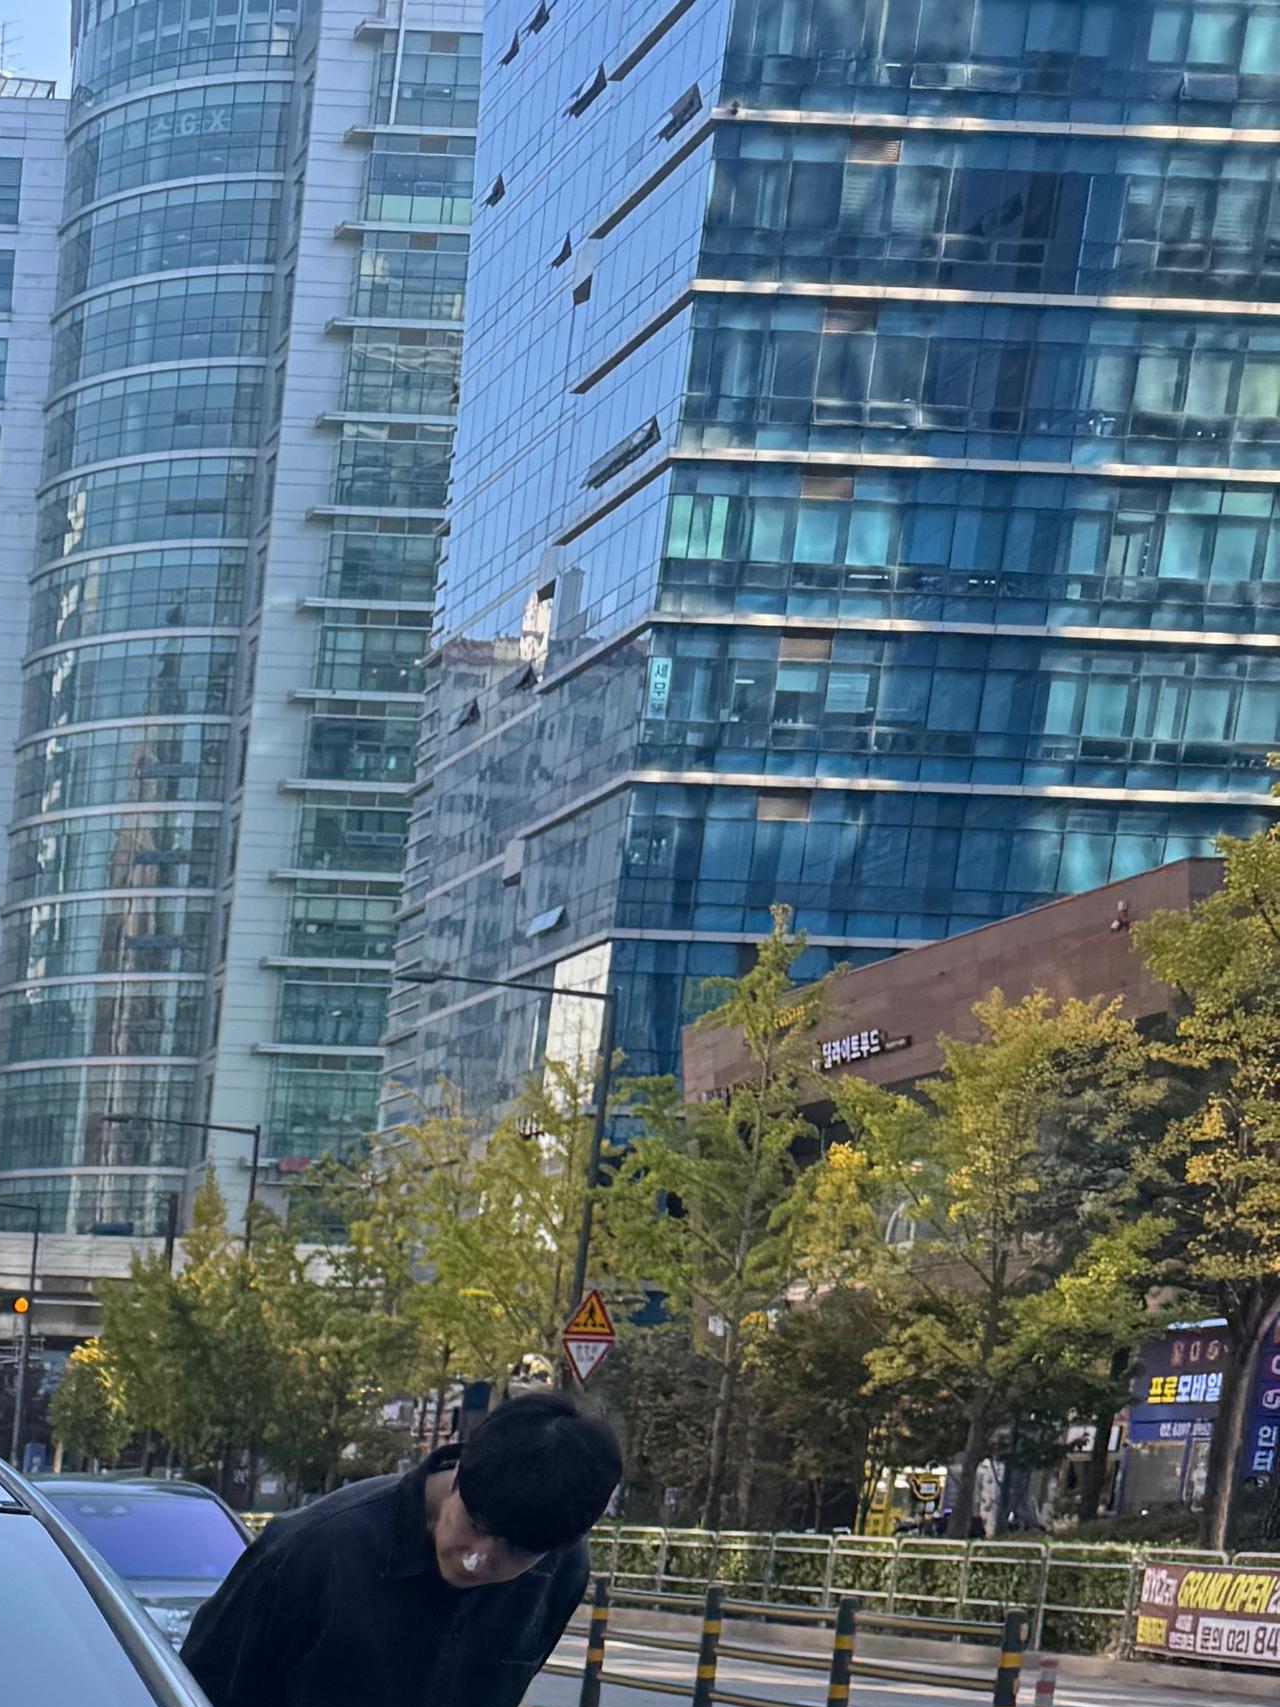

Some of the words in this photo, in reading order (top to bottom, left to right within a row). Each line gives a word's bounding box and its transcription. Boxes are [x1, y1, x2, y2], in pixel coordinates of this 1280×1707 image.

[1146, 1372, 1224, 1404] 프로모바일
[1177, 1570, 1234, 1611] GRAND
[1224, 1574, 1278, 1614] OPEN
[1226, 1629, 1250, 1653] 02)
